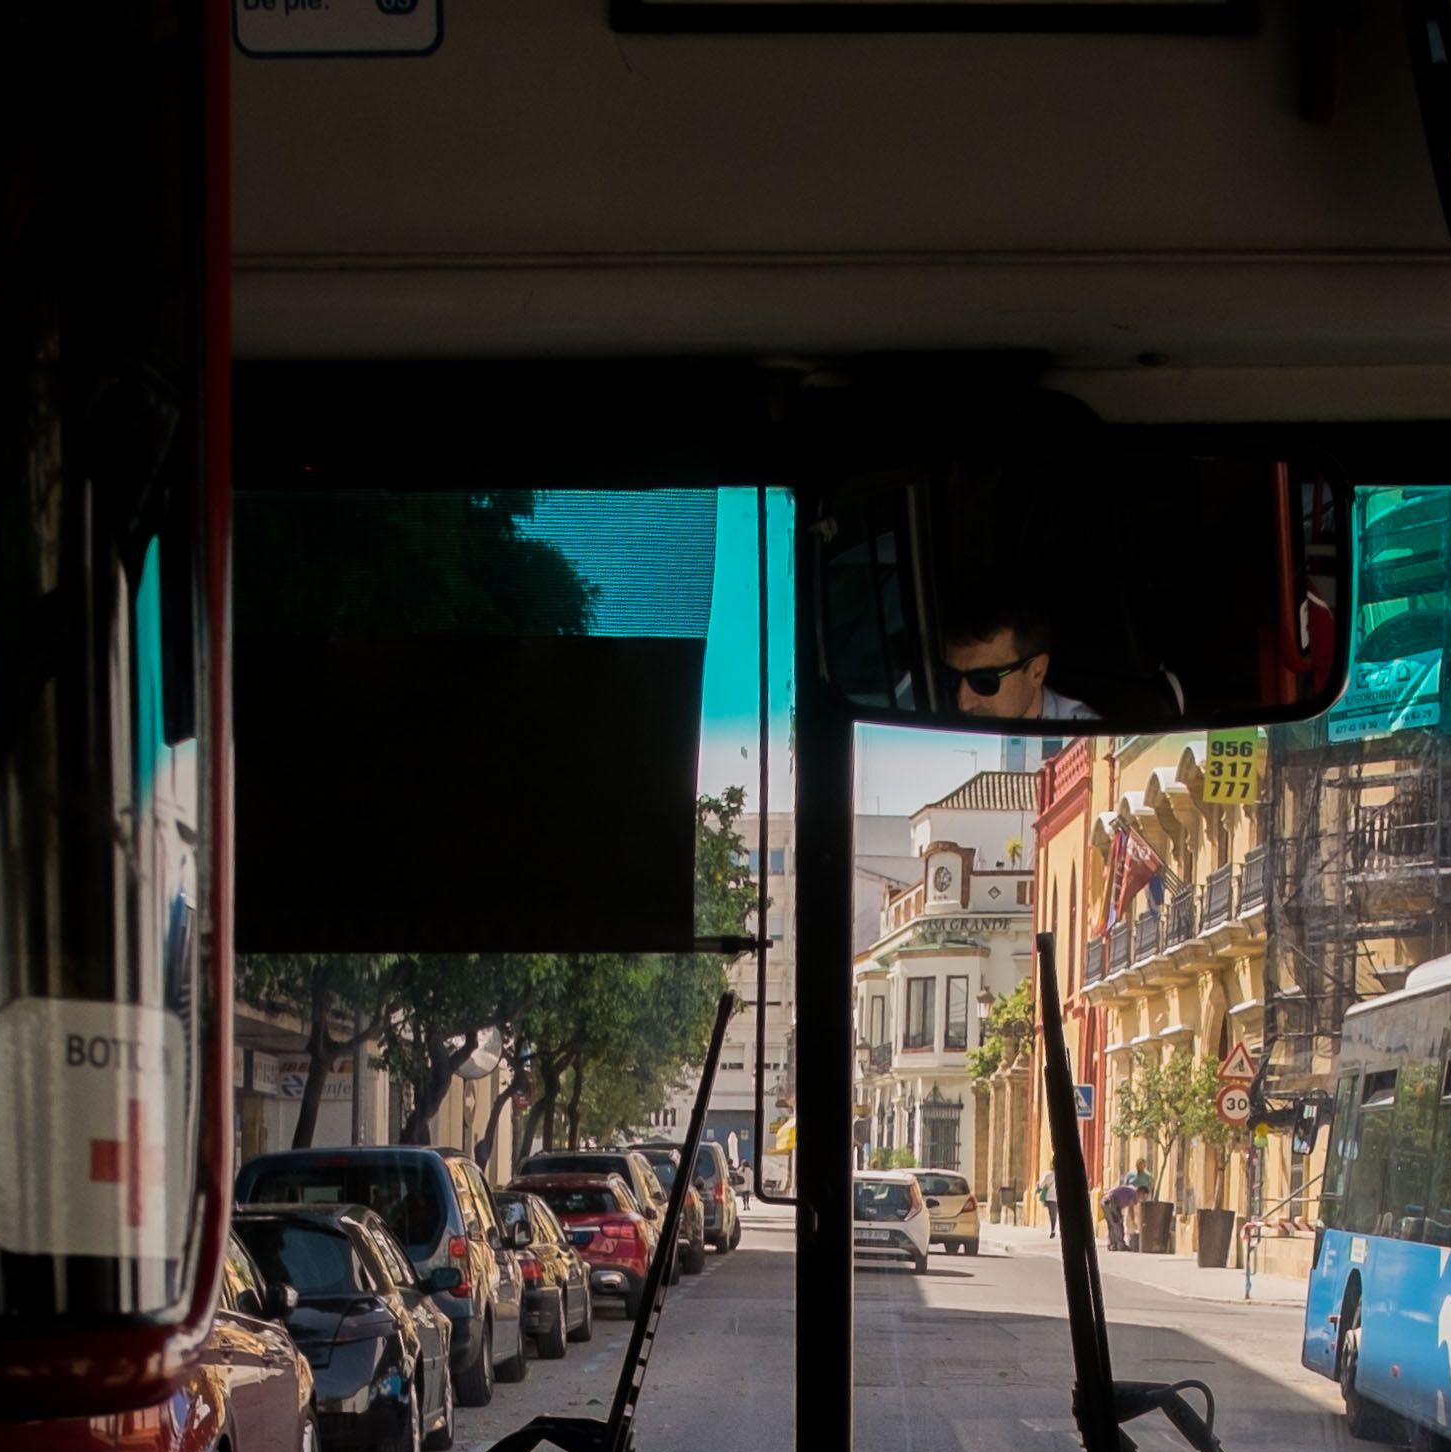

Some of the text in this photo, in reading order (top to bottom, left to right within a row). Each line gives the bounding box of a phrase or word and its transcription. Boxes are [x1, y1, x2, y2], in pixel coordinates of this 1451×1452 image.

[1210, 740, 1253, 758] 956
[1209, 761, 1252, 778] 317
[1210, 781, 1251, 799] 777
[949, 918, 1012, 931] GRANDE
[1225, 1097, 1249, 1113] 30
